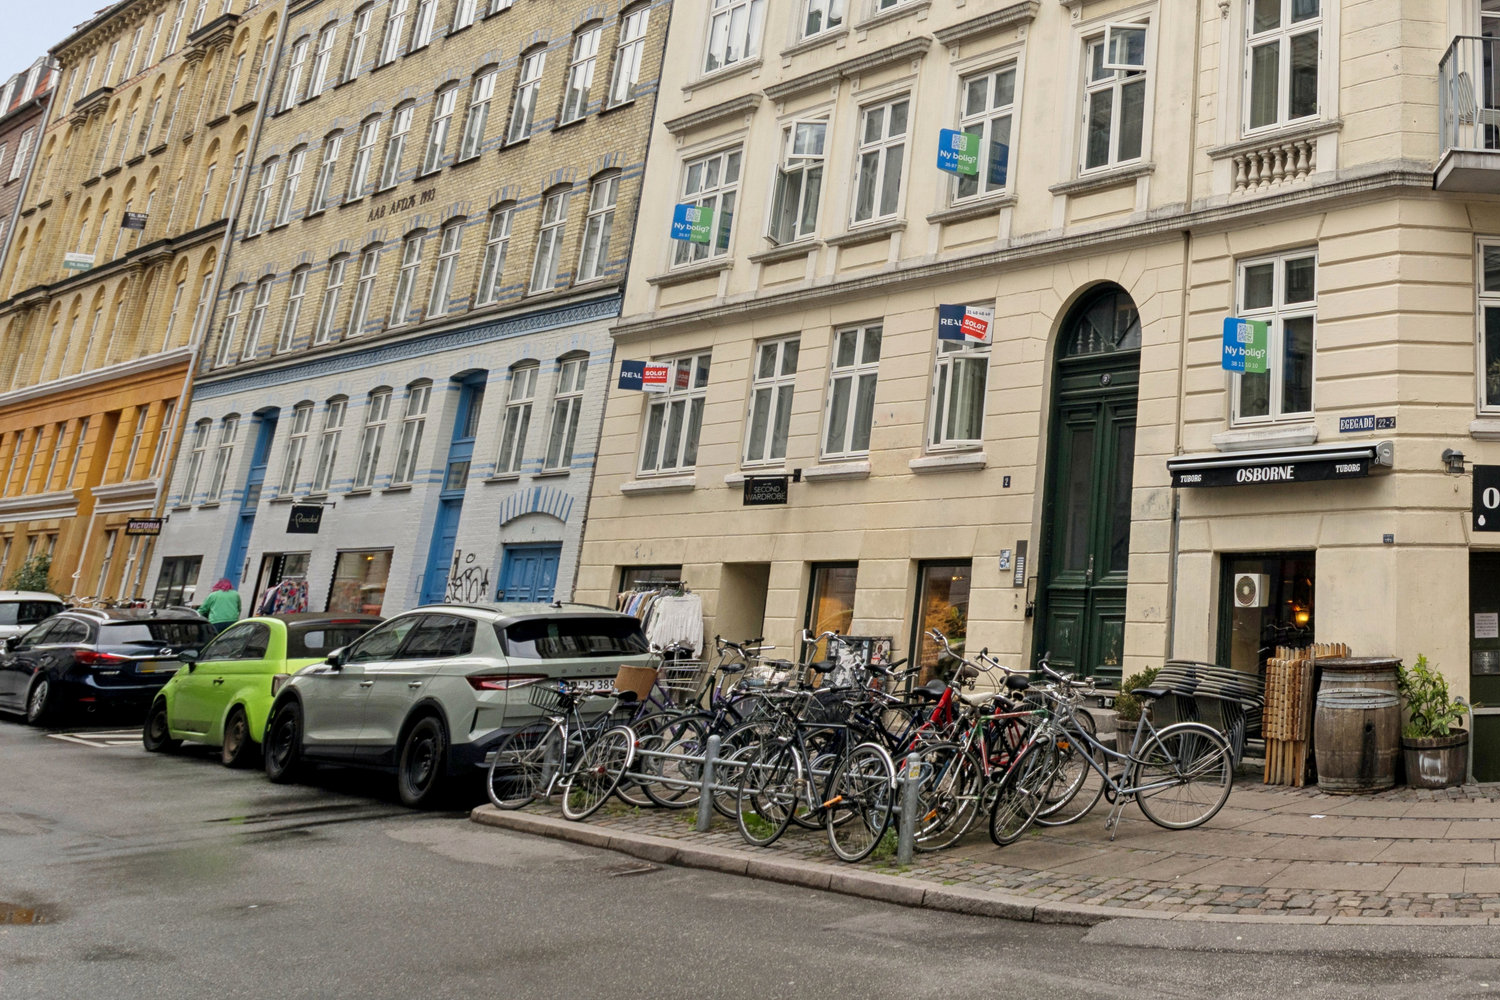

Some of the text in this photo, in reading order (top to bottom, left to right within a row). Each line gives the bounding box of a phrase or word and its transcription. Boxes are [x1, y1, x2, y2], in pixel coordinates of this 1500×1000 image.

[940, 150, 976, 164] Ny bolig?
[367, 205, 386, 222] AAB
[674, 222, 709, 233] Ny bolig?
[1225, 345, 1265, 359] Ny bolig?
[621, 371, 642, 379] REAL
[1340, 416, 1394, 430] EGEGADE 22-2
[1236, 465, 1295, 483] OSBORNE
[1335, 464, 1361, 473] TUBORG
[1180, 474, 1202, 482] TUBORG
[745, 492, 786, 501] WARDROBE
